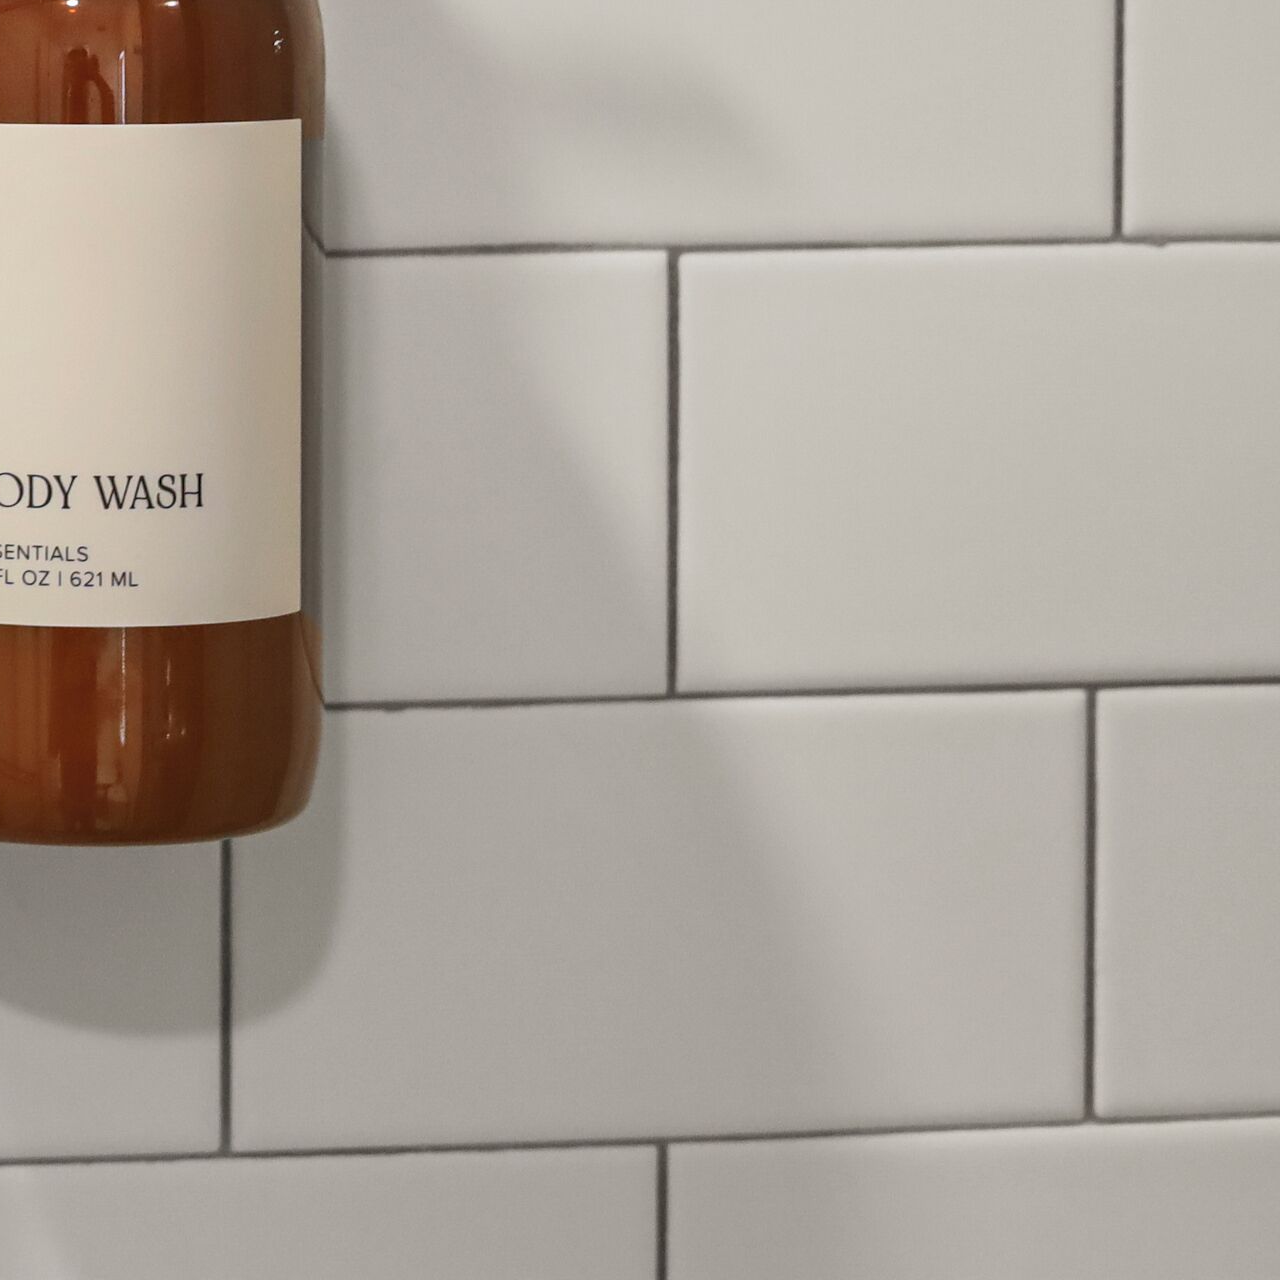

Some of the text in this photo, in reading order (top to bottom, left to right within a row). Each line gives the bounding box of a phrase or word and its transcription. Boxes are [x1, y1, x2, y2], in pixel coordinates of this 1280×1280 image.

[92, 472, 205, 511] WASH
[21, 569, 51, 587] OZ
[69, 570, 103, 588] 621
[110, 570, 140, 588] ML
